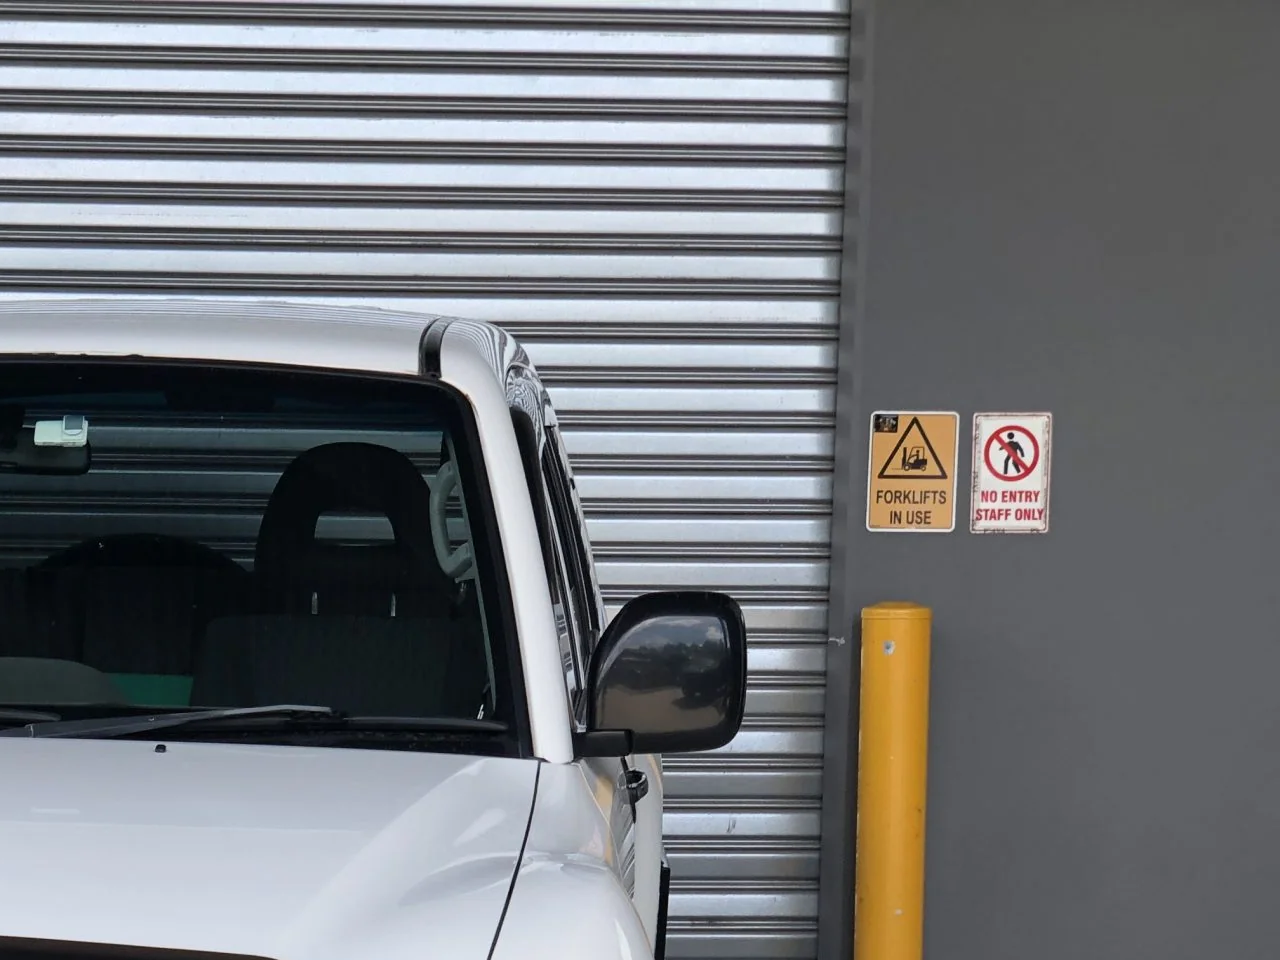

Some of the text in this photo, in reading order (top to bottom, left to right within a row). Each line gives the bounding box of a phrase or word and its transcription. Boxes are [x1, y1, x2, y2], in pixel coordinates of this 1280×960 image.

[876, 490, 947, 505] FORKLIFTS
[980, 490, 1040, 503] NO ENTRY
[889, 510, 932, 525] IN USE
[975, 508, 1044, 521] STAFF ONLY
